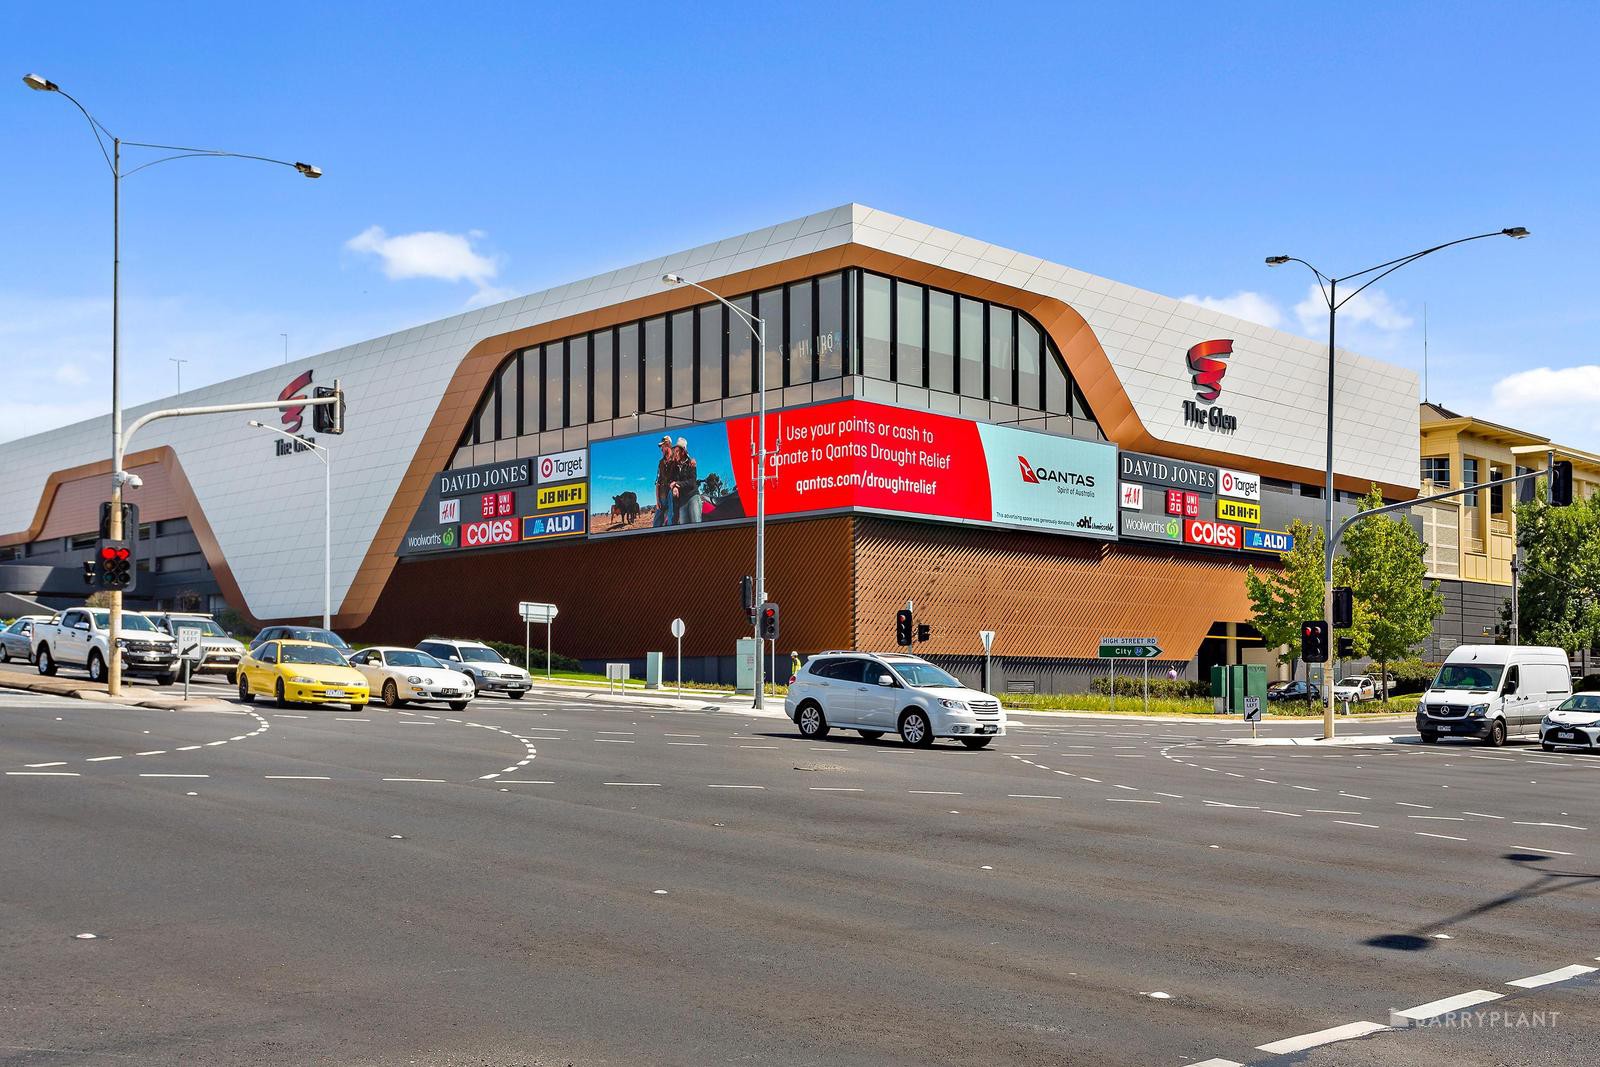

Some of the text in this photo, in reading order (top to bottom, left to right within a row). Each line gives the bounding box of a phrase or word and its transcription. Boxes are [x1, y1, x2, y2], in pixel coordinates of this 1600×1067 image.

[1182, 399, 1237, 431] The Glen
[786, 416, 934, 444] Use your points or cash to
[274, 438, 292, 456] The
[769, 441, 951, 470] donate to Qantas Drought Relief
[553, 456, 583, 476] Target
[1123, 457, 1215, 488] DAVID JONES
[441, 464, 527, 493] DAVID JONES
[796, 470, 937, 495] qantas.com/droughtrelief
[1036, 467, 1095, 488] QANTAS
[1233, 477, 1258, 496] Target
[498, 493, 510, 504] UNI
[540, 490, 555, 504] JB
[1057, 485, 1095, 498] Spirit of Australia
[1186, 496, 1197, 505] UNI
[498, 504, 511, 515] QLO
[1186, 505, 1198, 514] QLO
[1221, 504, 1235, 516] JB
[546, 515, 575, 533] ALDI
[1004, 512, 1023, 522] advertising
[1040, 517, 1058, 526] generously
[1125, 518, 1165, 533] Woolworths
[408, 534, 442, 547] Woolworths
[466, 520, 513, 545] coles
[1191, 521, 1237, 546] coles
[1263, 534, 1287, 550] ALDI
[1115, 648, 1132, 656] City
